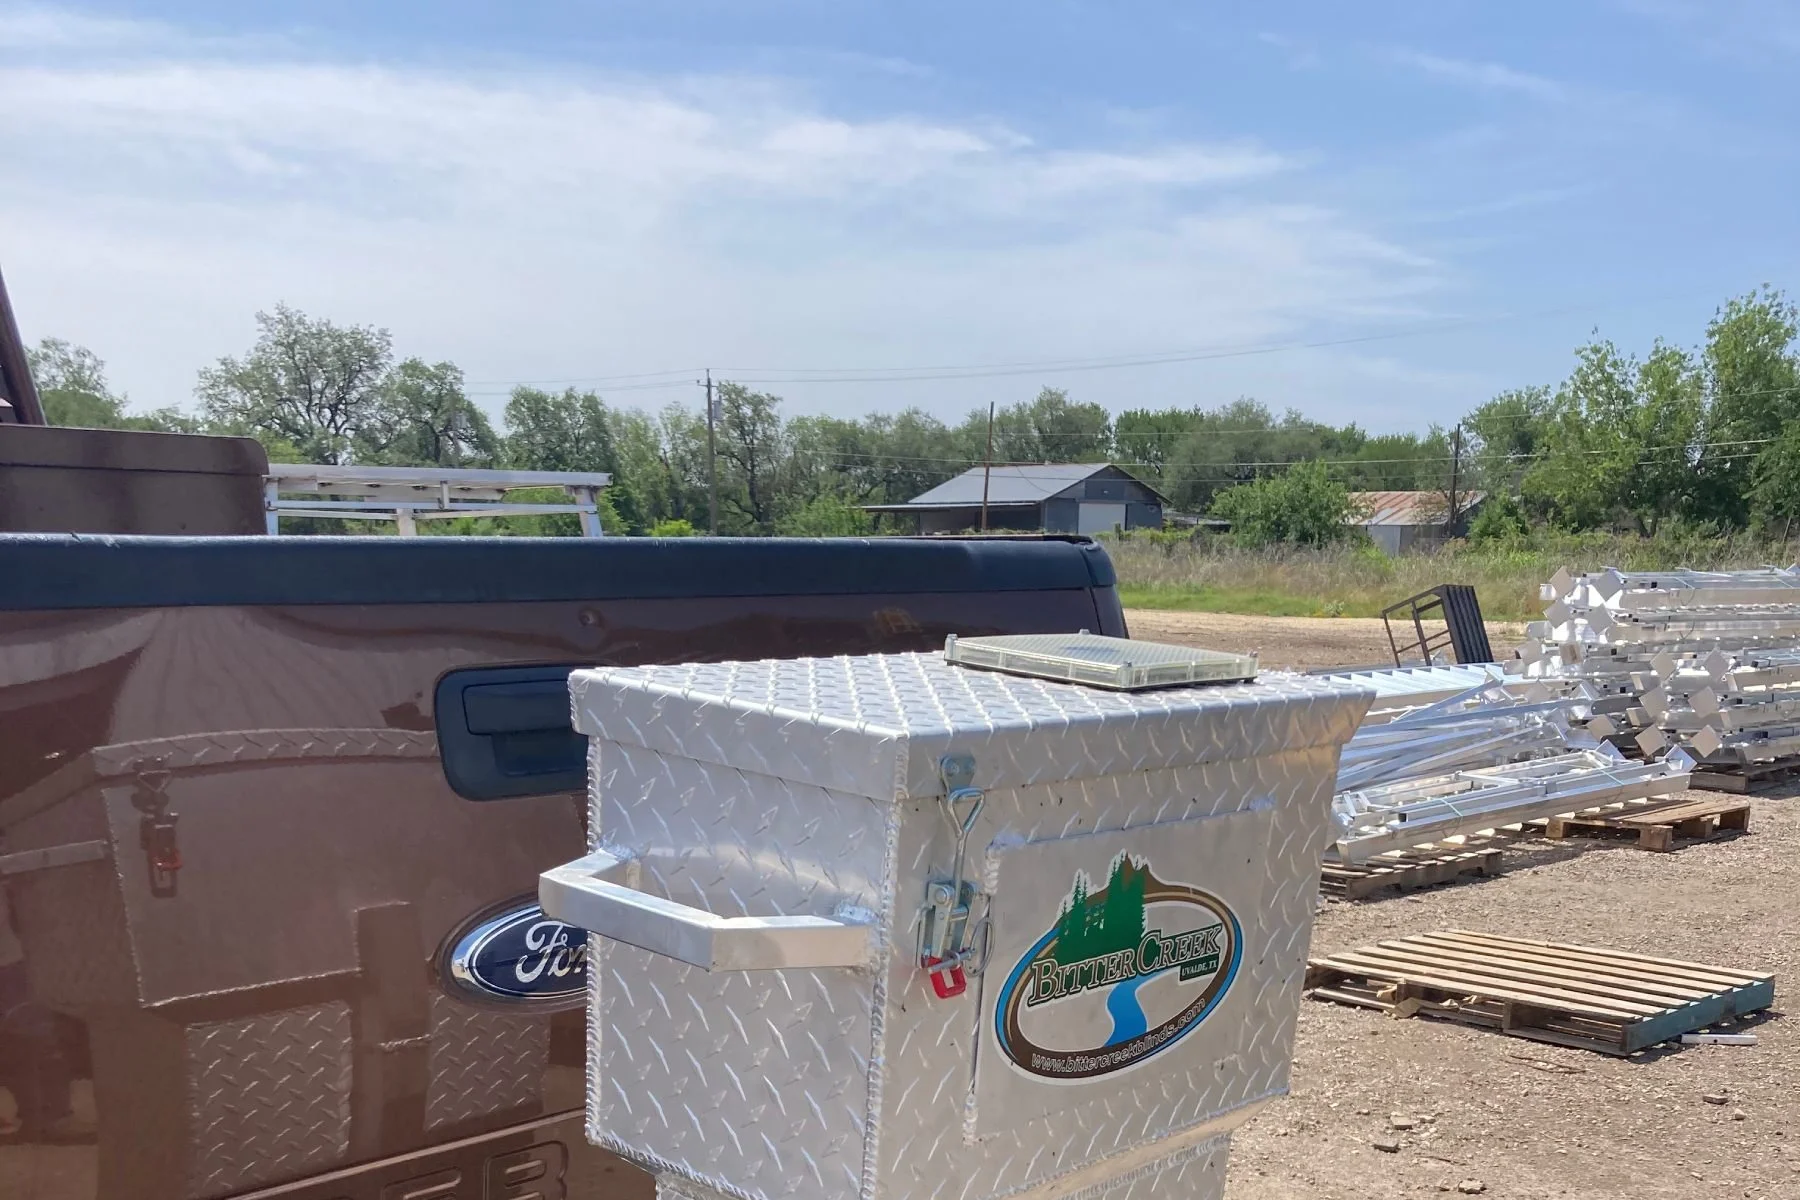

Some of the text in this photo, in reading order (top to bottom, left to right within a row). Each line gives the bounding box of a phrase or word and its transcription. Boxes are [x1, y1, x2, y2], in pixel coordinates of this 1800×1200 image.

[515, 920, 587, 983] For
[1027, 924, 1222, 1006] BITTER CREEK
[1031, 997, 1206, 1073] www.bittercreekblinds.com
